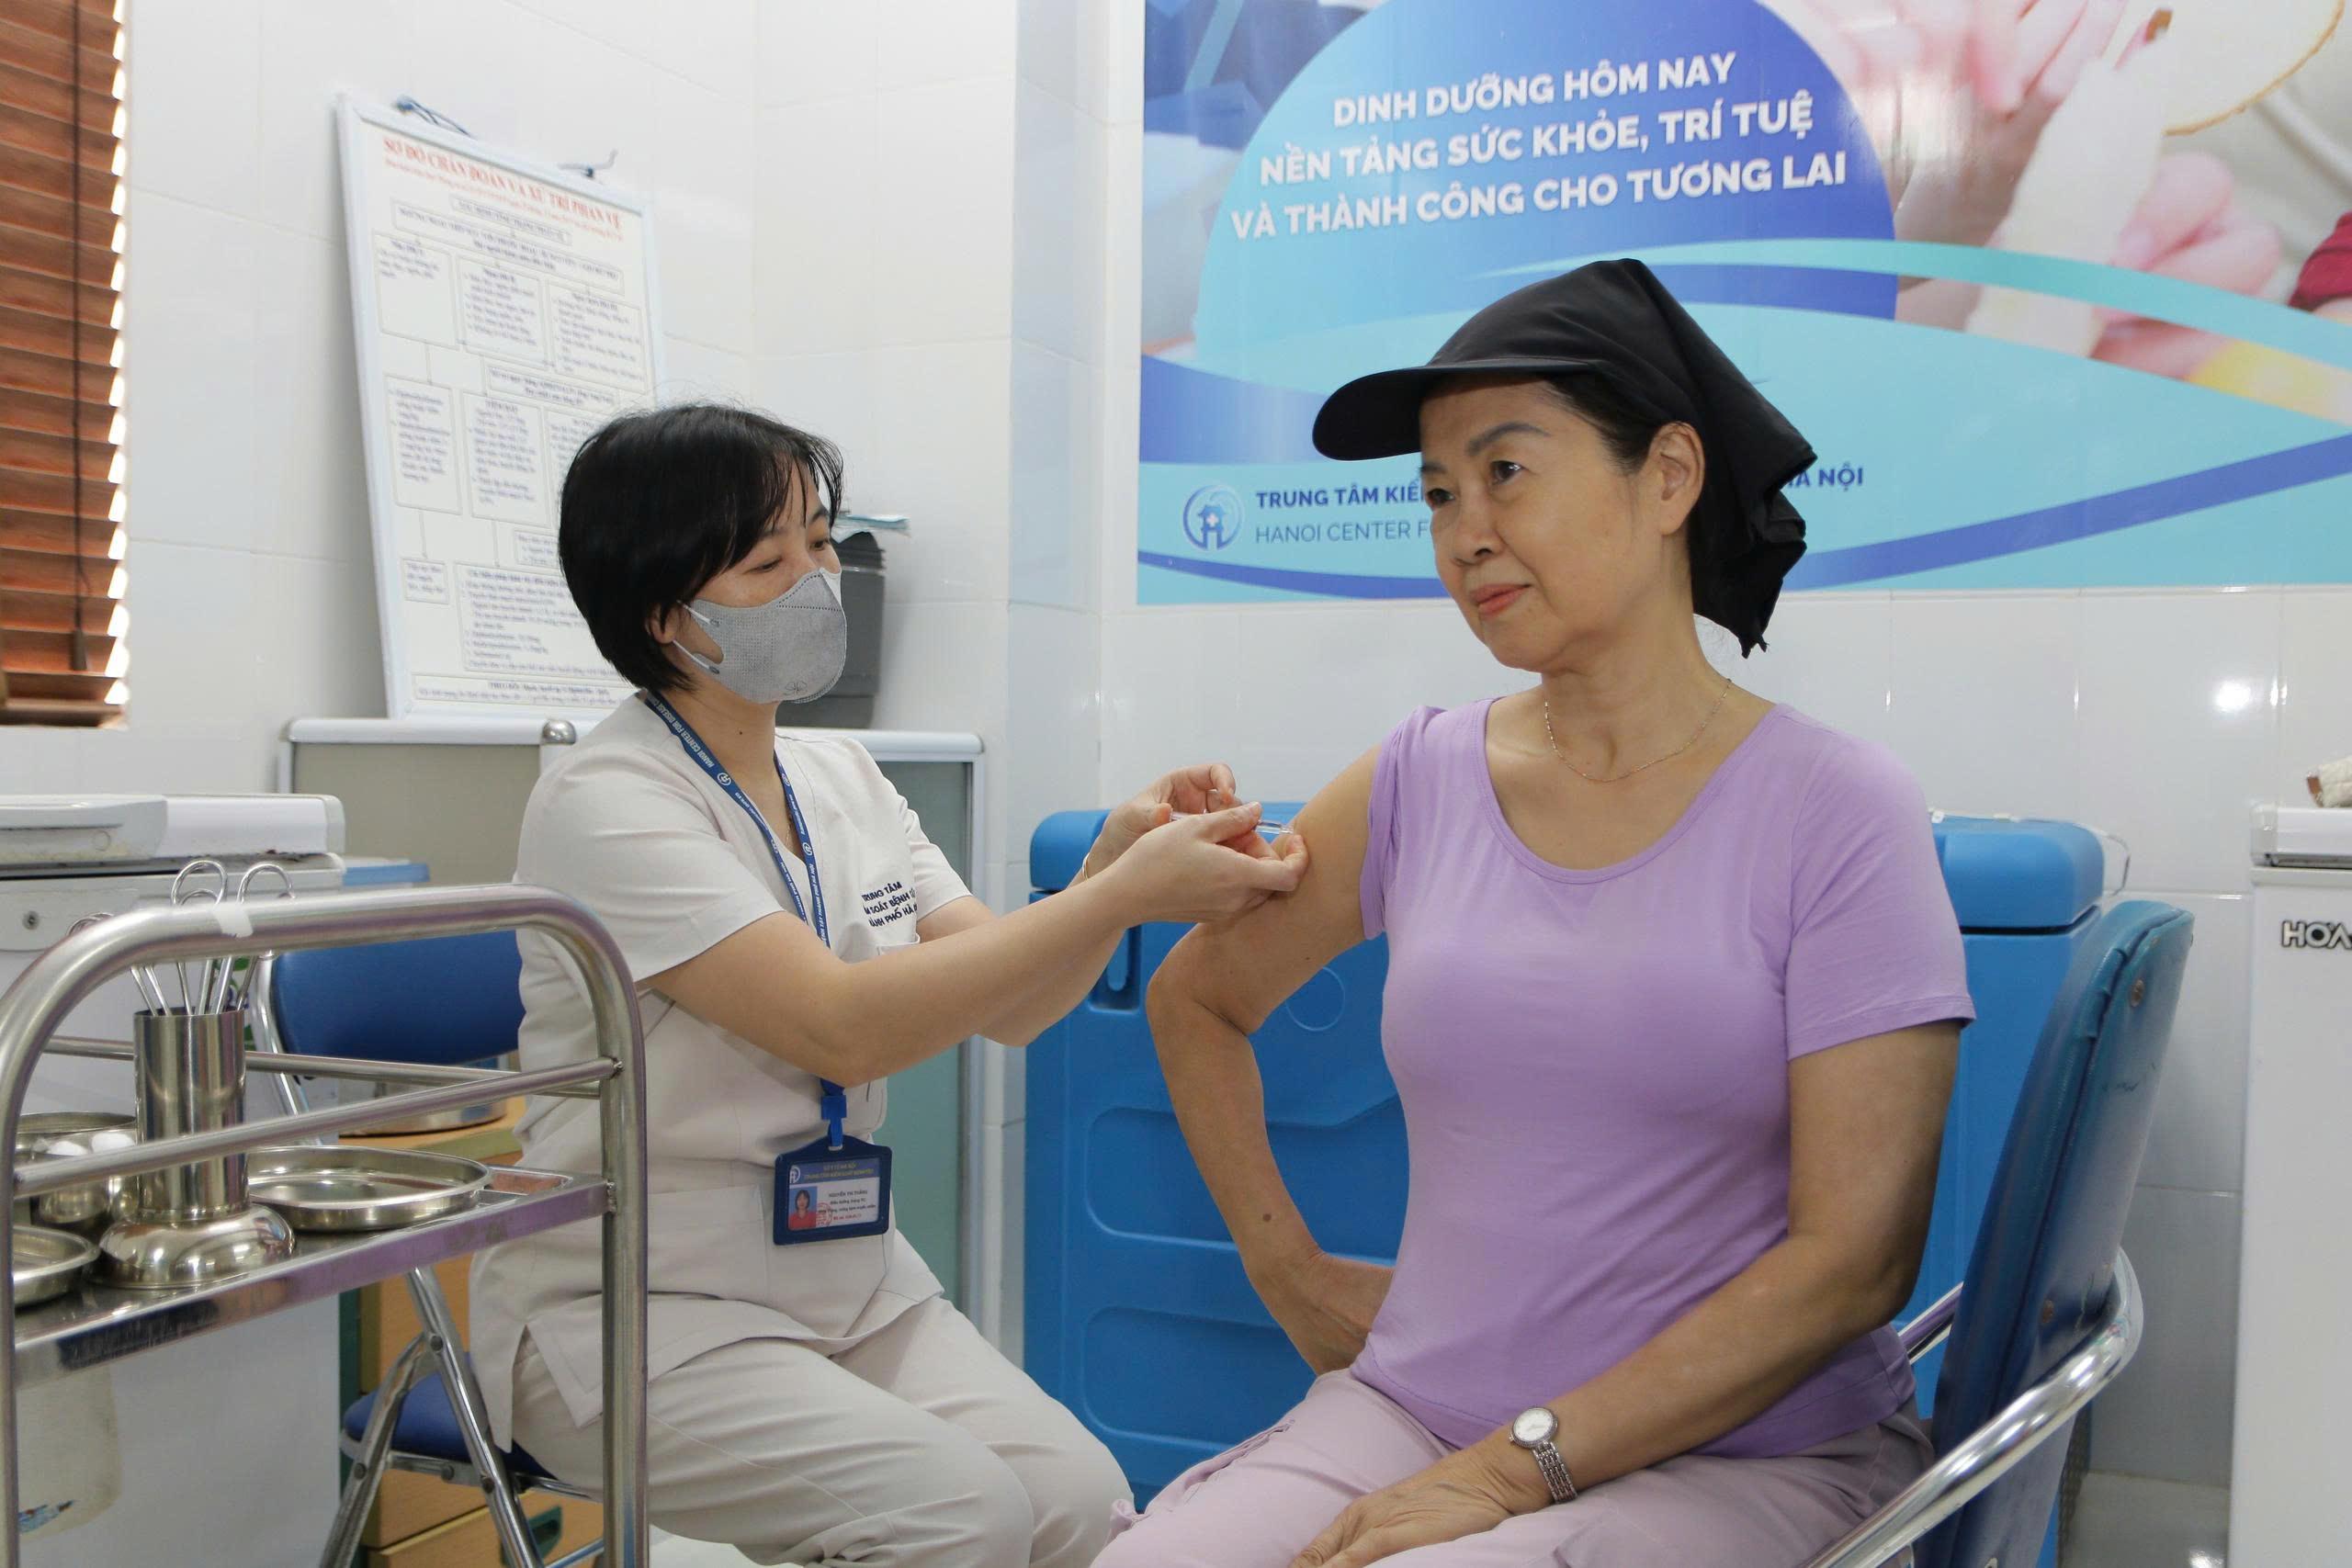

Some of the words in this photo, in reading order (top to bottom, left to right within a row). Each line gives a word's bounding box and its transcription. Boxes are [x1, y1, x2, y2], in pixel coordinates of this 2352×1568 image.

[1334, 89, 1417, 128] DINH
[1426, 72, 1555, 117] DƯỠNG
[1564, 59, 1648, 102] HÔM
[1657, 51, 1736, 91] NAY
[1261, 141, 1330, 186] NỀN
[1340, 134, 1440, 178] TẢNG
[1447, 122, 1523, 167] SỨC
[1532, 107, 1650, 158] KHỎE,
[1657, 96, 1724, 144] TRÍ
[1731, 88, 1814, 140] TUỆ
[1232, 200, 1277, 241] VÀ
[1283, 192, 1408, 235] THÀNH
[1416, 180, 1525, 223] CÔNG
[1533, 174, 1619, 212] CHO
[1625, 158, 1773, 204] TƯƠNG
[1782, 149, 1847, 190] LAI
[1256, 489, 1329, 509] TRUNG
[1334, 481, 1379, 506] TÂM
[1818, 461, 1863, 491] NỘI
[1255, 524, 1321, 544] HANOI
[1327, 520, 1411, 543] CENTER
[884, 881, 903, 894] TÂM
[888, 891, 910, 908] BỆNH
[885, 906, 903, 923] PHỐ
[902, 903, 914, 916] HÀ
